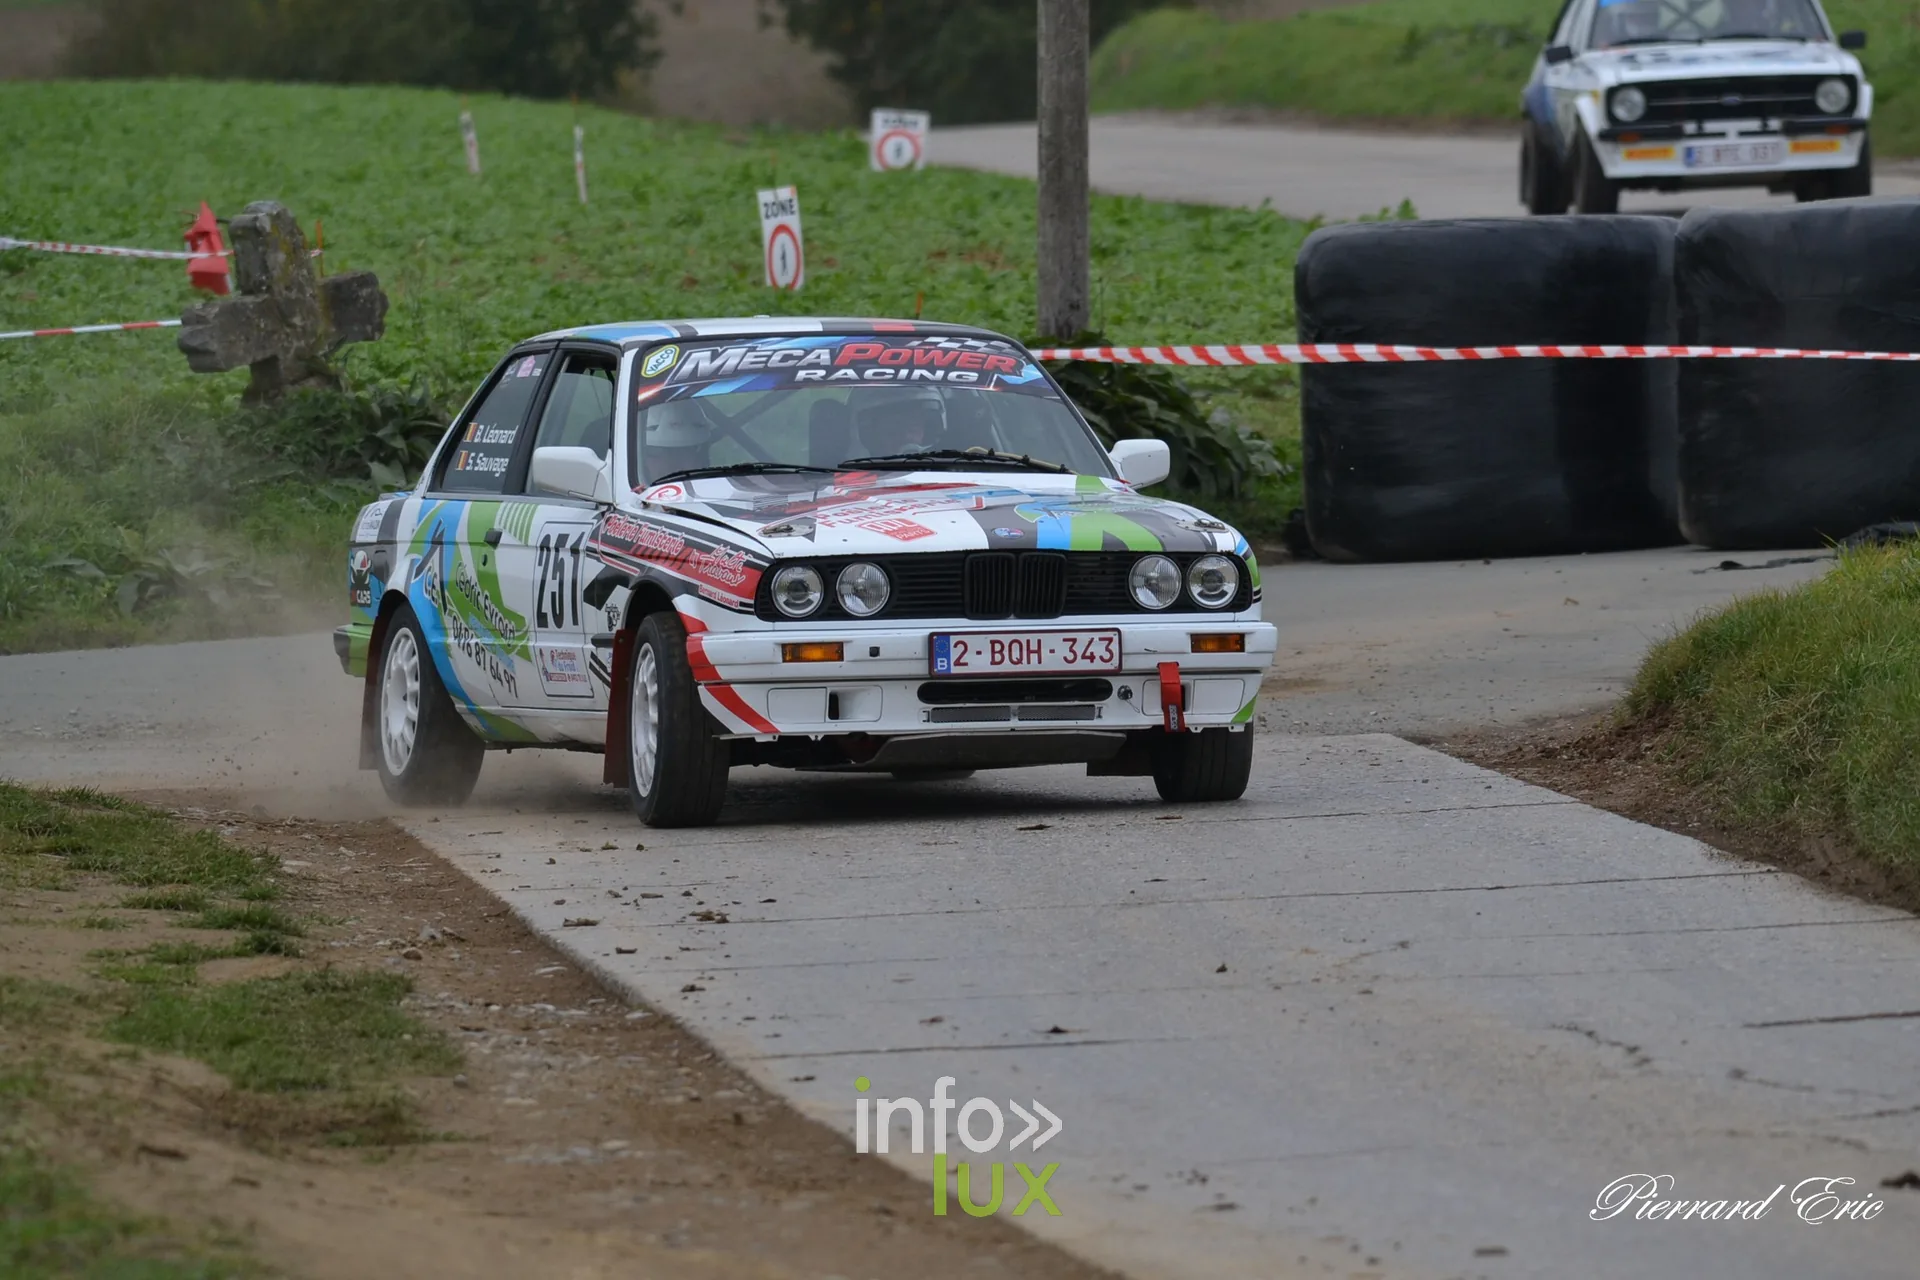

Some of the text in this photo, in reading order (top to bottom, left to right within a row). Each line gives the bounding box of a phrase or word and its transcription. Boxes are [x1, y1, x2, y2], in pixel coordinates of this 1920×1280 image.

[764, 199, 796, 219] ZONE
[647, 348, 674, 372] YACCO
[794, 368, 979, 382] RACING
[482, 423, 519, 444] Léonard
[474, 452, 509, 477] Sauvage
[536, 532, 585, 629] 251
[475, 641, 487, 671] 87
[490, 655, 504, 687] 64
[503, 669, 519, 699] 97
[937, 657, 948, 670] B
